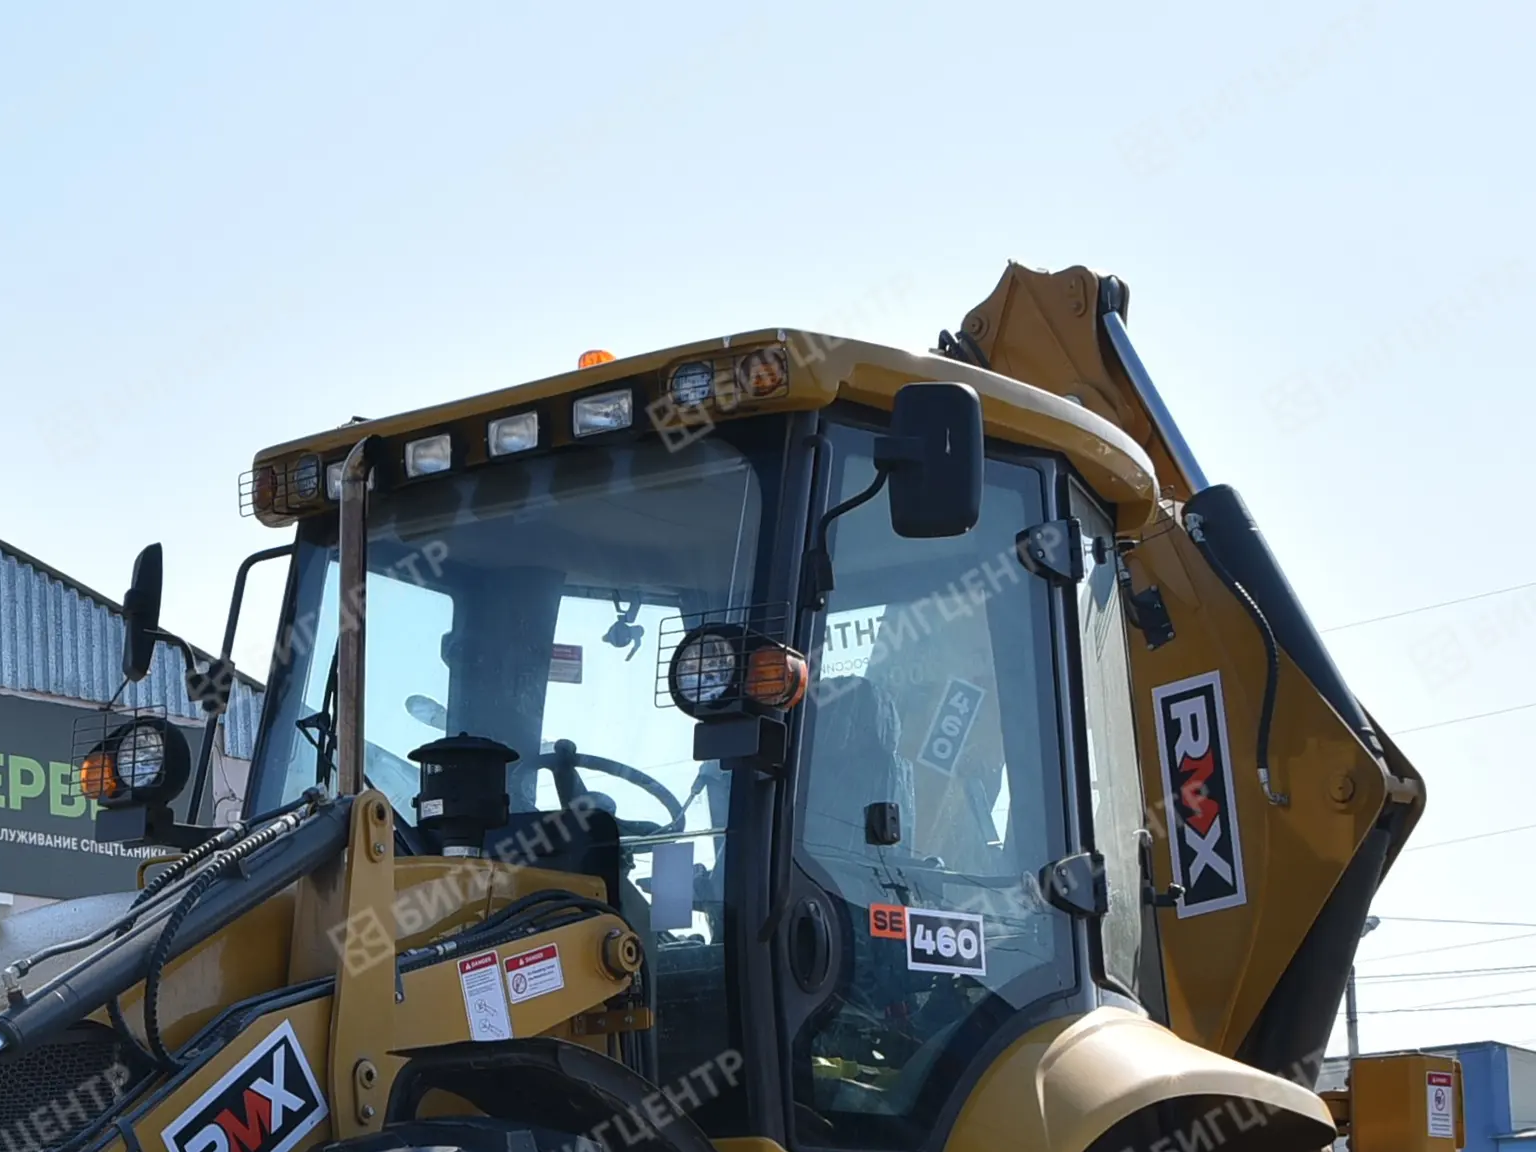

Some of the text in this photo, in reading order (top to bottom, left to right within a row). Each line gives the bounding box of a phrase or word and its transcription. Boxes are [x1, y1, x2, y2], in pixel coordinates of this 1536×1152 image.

[1169, 695, 1234, 889] RMX
[872, 909, 904, 933] SE
[913, 924, 979, 960] 460
